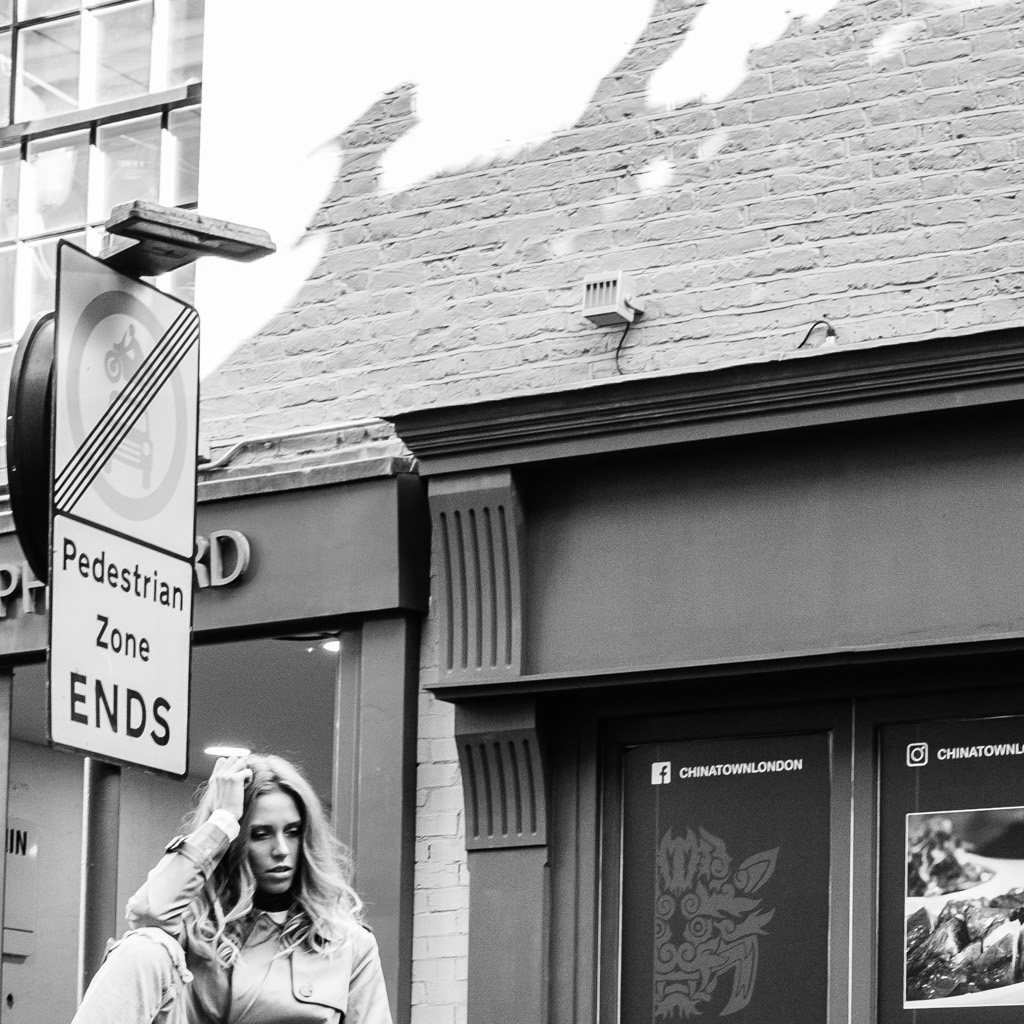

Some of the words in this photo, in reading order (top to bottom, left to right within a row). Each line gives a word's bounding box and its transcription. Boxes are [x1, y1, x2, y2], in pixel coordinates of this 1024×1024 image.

[62, 537, 184, 612] Pedestrian
[96, 613, 150, 662] Zone
[70, 671, 171, 747] ENDS
[679, 758, 803, 779] CHINATOWNLONDON
[5, 828, 27, 856] IN
